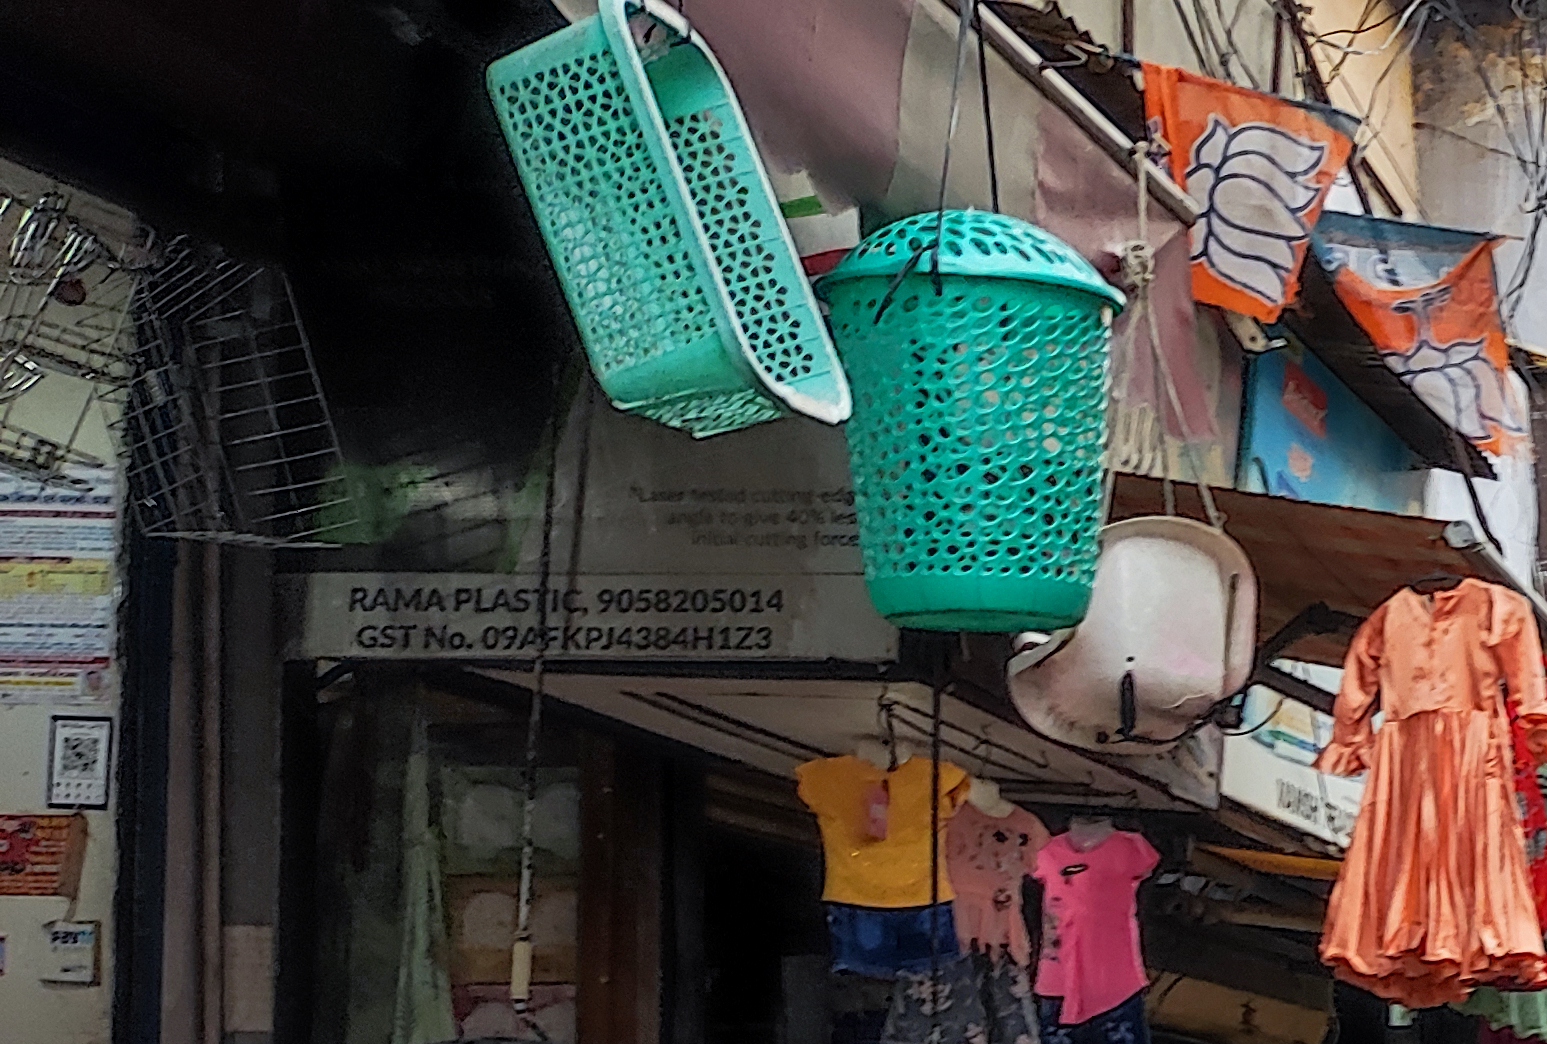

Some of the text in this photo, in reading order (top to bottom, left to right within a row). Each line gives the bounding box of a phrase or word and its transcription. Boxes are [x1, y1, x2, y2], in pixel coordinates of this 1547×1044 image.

[348, 587, 785, 617] RAMA PLASTIC, 9058205014
[355, 623, 418, 649] GST
[423, 624, 473, 650] No.
